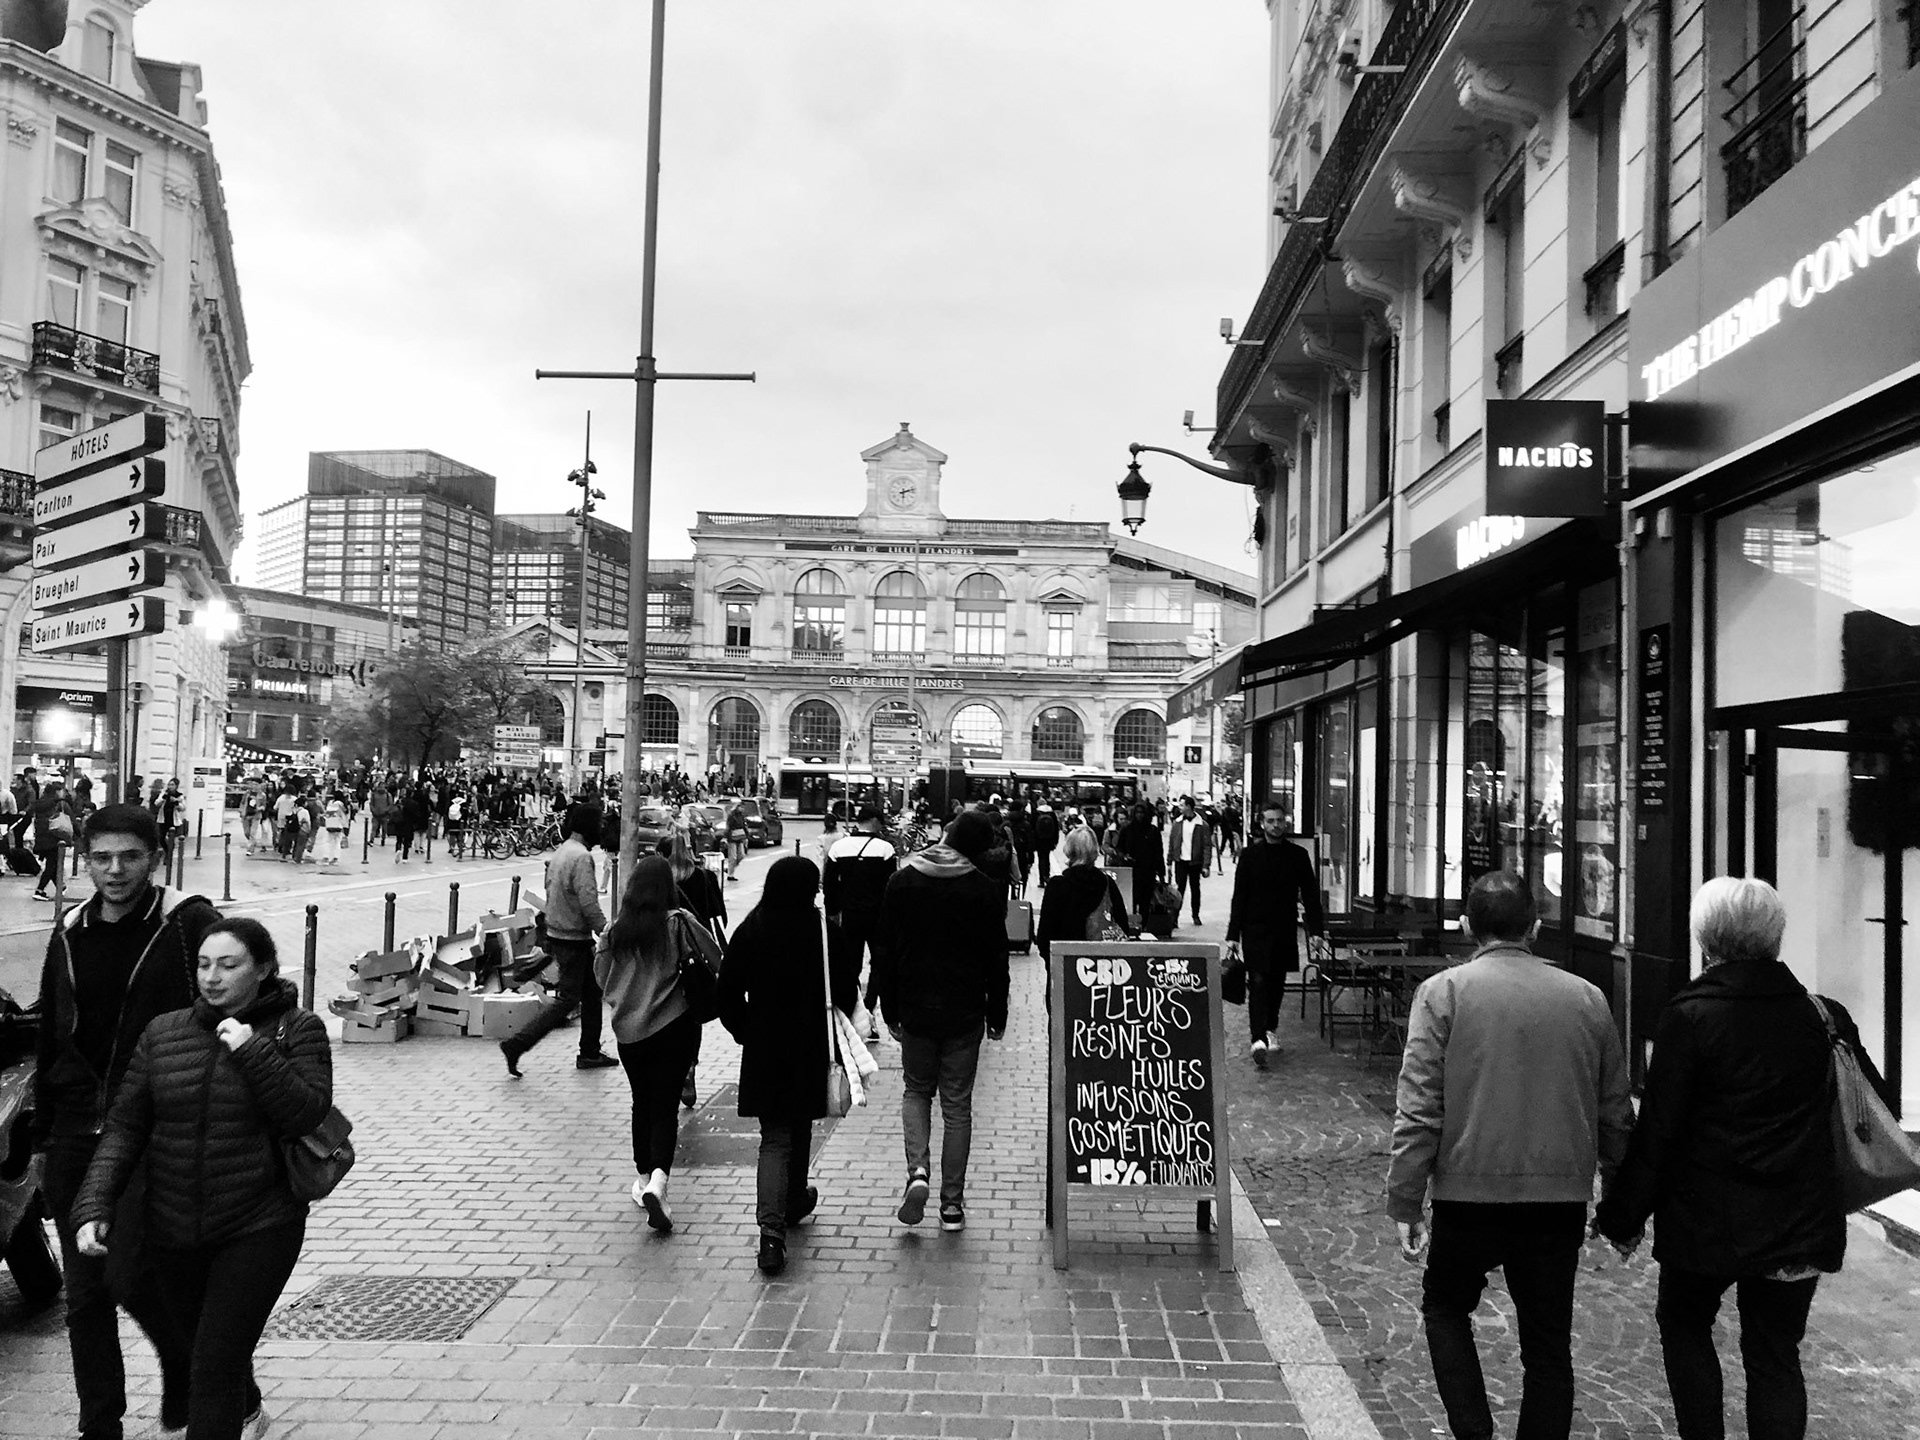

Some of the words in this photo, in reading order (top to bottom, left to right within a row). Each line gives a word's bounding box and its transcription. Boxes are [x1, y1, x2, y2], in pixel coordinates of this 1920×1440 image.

[1640, 334, 1699, 402] THE
[1697, 276, 1789, 370] HEMP
[71, 433, 109, 461] HÔTELS
[1498, 443, 1593, 468] NACHOS
[36, 494, 73, 516] Carlton
[35, 542, 57, 558] Paix
[888, 546, 914, 554] LILLE
[924, 547, 975, 555] FLANDRES
[35, 575, 79, 600] Brueghel
[34, 623, 61, 643] Saint
[65, 616, 107, 637] Maurice
[254, 680, 308, 694] PRIMARK
[828, 675, 858, 686] GARE
[862, 677, 877, 687] DE
[881, 677, 906, 688] LILLE
[909, 678, 964, 689] LANDRES
[59, 692, 94, 702] Aprium
[1076, 957, 1133, 987] CBD
[1090, 985, 1192, 1030] FLEURS
[1072, 1018, 1171, 1061] RÉSINES
[1131, 1059, 1205, 1091] HUILES
[1076, 1080, 1193, 1124] INFUSIONS
[1068, 1117, 1213, 1165] COSMÉTIQUES
[1077, 1158, 1147, 1186] -15%
